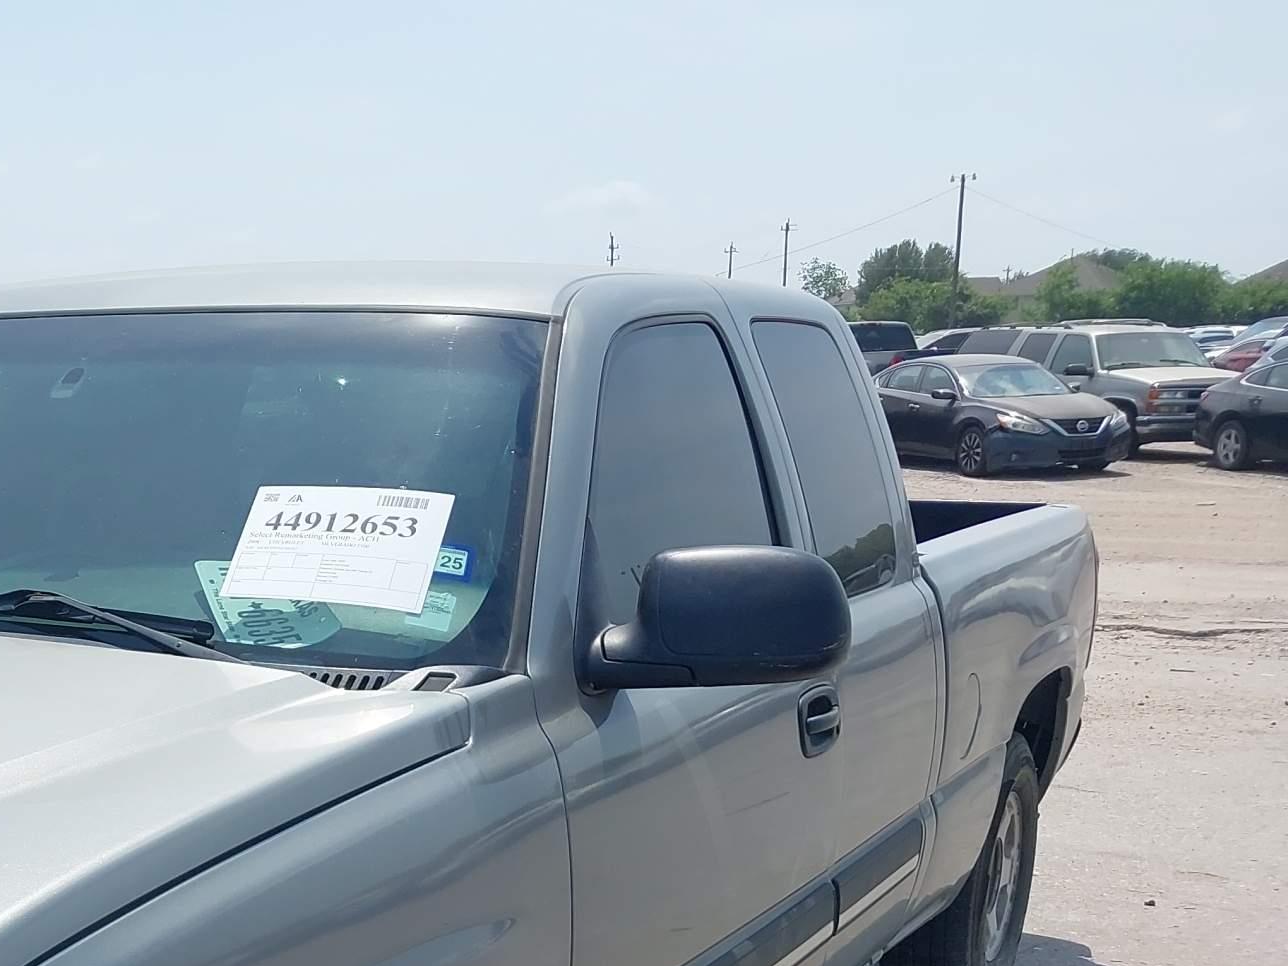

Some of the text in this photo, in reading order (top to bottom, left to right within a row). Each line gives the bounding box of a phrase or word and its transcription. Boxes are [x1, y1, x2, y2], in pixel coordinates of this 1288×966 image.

[265, 511, 418, 538] 44912653
[249, 531, 273, 539] Select
[274, 531, 323, 541] Remarketing
[325, 533, 351, 542] Group
[439, 555, 464, 570] 25
